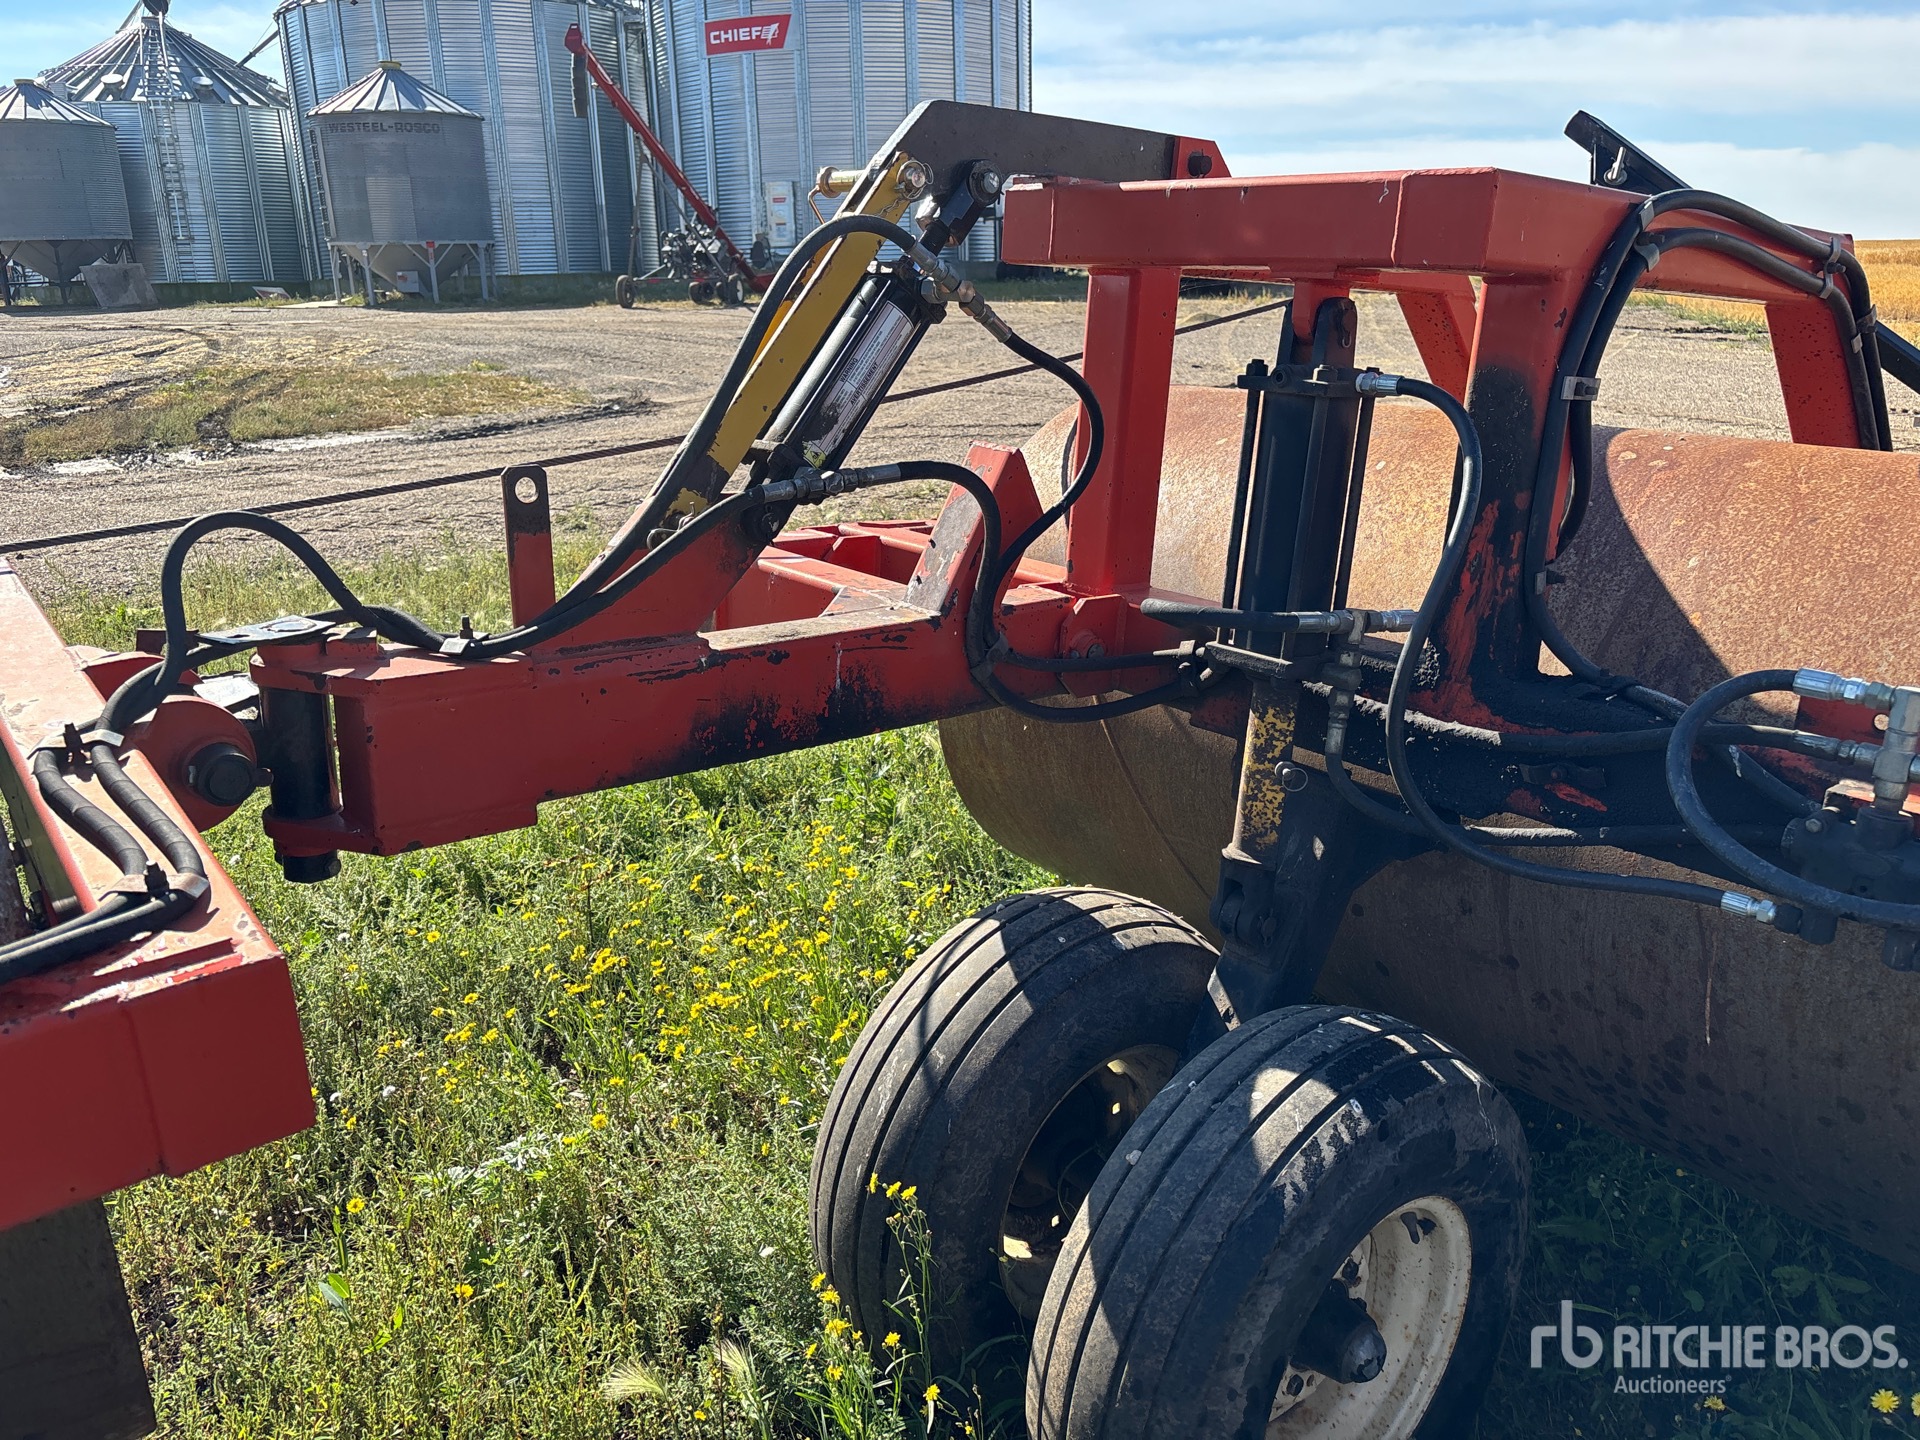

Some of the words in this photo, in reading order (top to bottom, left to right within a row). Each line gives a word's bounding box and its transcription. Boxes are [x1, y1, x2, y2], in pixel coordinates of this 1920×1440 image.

[709, 26, 762, 45] CHIEF
[328, 122, 441, 134] WESTEEL-ROSCO
[839, 357, 859, 383] WARNING
[850, 361, 879, 406] AVERTISSEMENT
